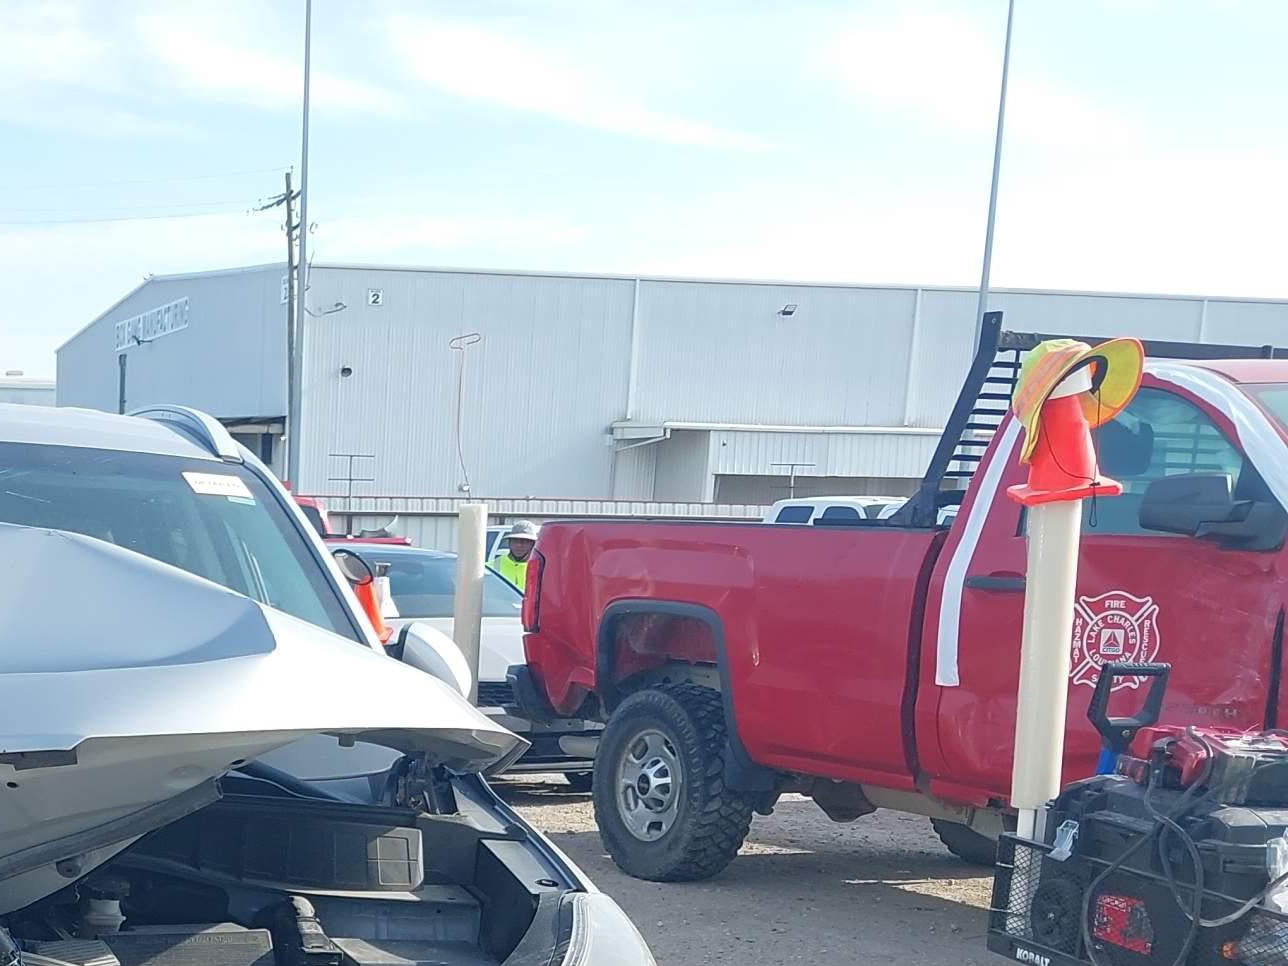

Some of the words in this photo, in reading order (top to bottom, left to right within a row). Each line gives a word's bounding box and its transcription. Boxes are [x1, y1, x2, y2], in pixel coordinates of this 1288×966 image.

[372, 293, 380, 304] 2
[1105, 600, 1127, 609] FIRE
[1087, 619, 1105, 643] LAKE
[1107, 615, 1137, 645] CHARLES
[1072, 617, 1083, 664] HAZMAT
[1091, 673, 1123, 684] STY
